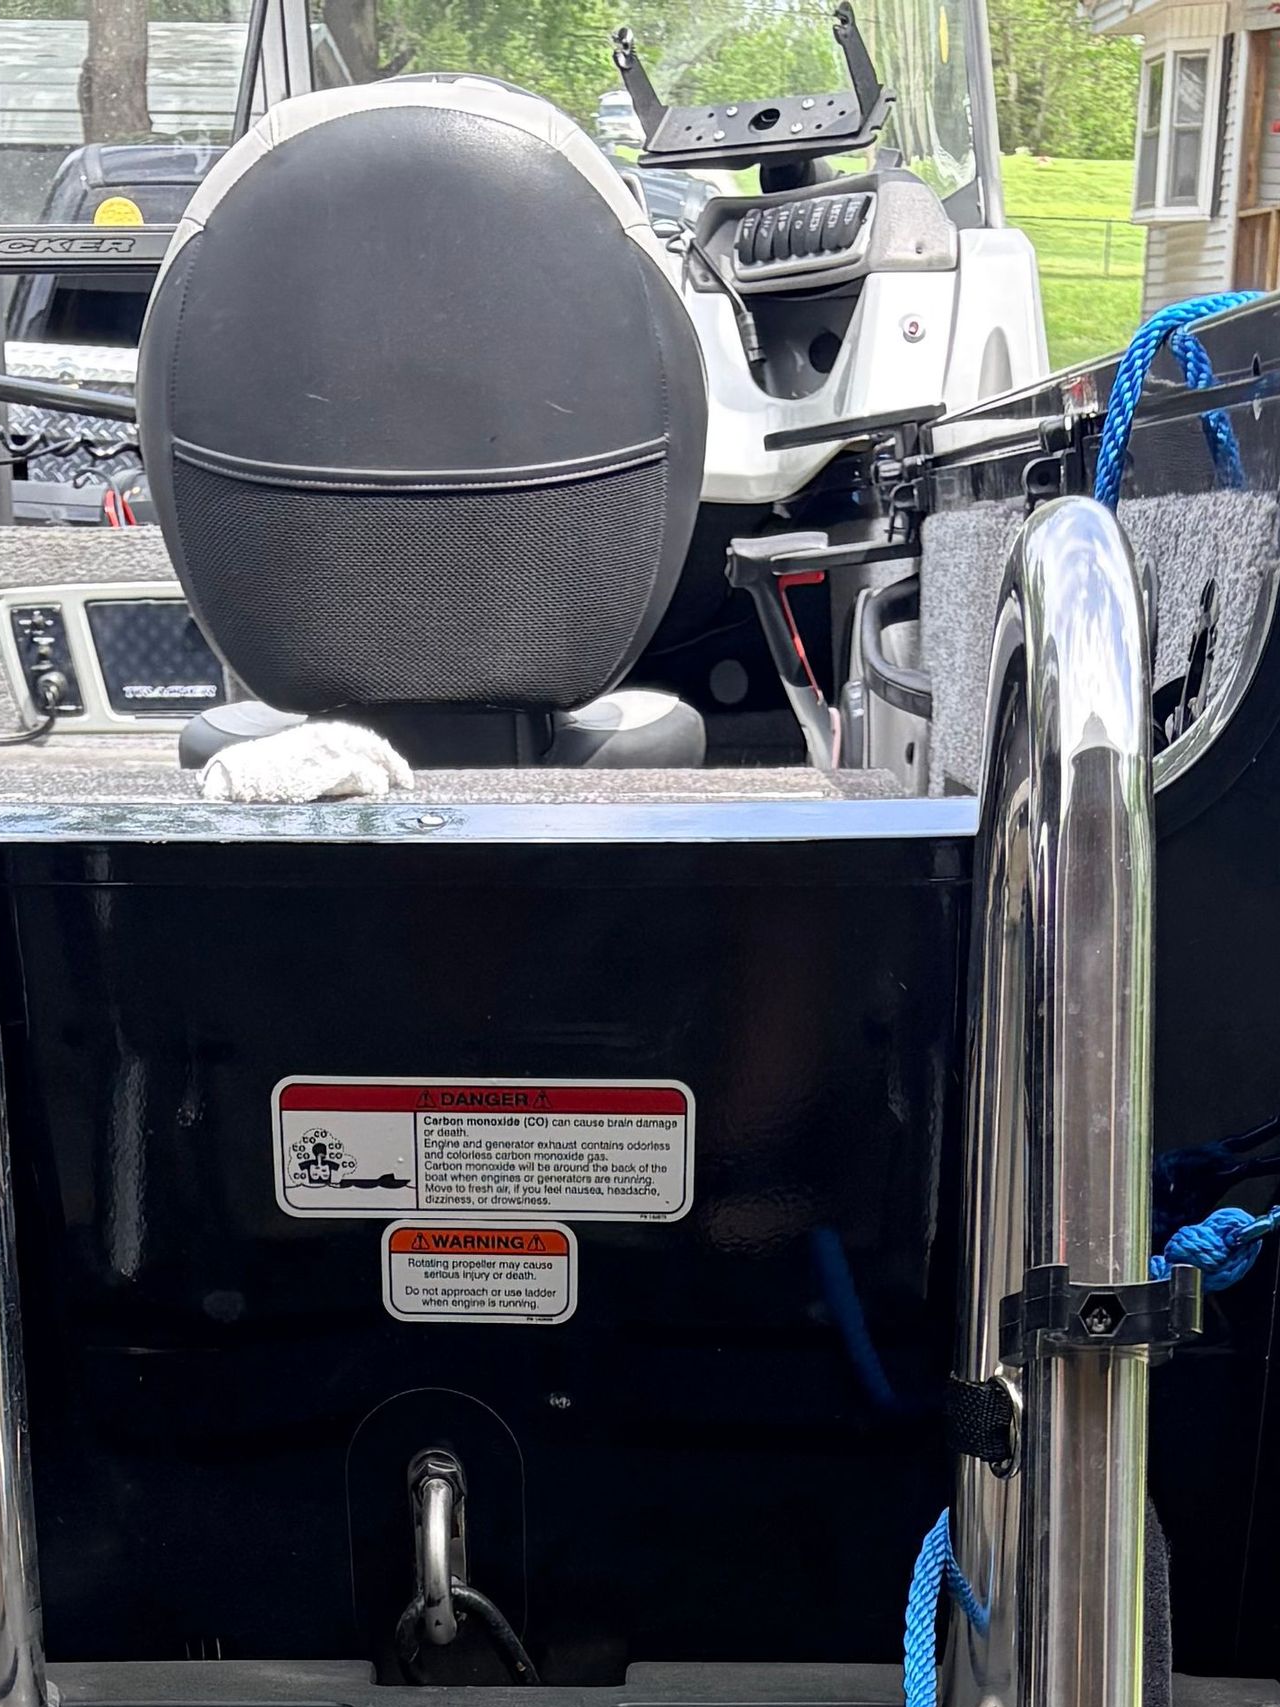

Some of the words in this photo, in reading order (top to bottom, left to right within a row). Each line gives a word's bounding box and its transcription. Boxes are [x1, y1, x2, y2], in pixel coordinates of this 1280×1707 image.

[441, 1092, 528, 1106] DANGER
[423, 1116, 463, 1125] Carbon
[467, 1117, 520, 1126] monoxide
[524, 1117, 548, 1128] (CO)
[552, 1119, 570, 1127] can
[608, 1118, 632, 1127] brain
[636, 1119, 677, 1130] damage
[314, 1130, 327, 1138] CO
[438, 1128, 468, 1137] death.
[424, 1139, 459, 1151] Engine
[463, 1139, 481, 1148] and
[485, 1140, 534, 1150] generator
[538, 1140, 577, 1150] exhaust
[582, 1141, 624, 1150] contains
[627, 1141, 670, 1150] odorless
[424, 1151, 443, 1159] and
[447, 1151, 492, 1159] colorless
[496, 1151, 530, 1160] carbon
[534, 1151, 584, 1161] monoxide
[588, 1154, 608, 1162] gas.
[424, 1161, 462, 1170] Carbon
[465, 1161, 515, 1171] monoxide
[518, 1162, 534, 1171] will
[538, 1163, 550, 1171] be
[554, 1163, 589, 1172] around
[592, 1163, 608, 1172] the
[612, 1163, 636, 1172] back
[639, 1164, 648, 1173] of
[651, 1164, 667, 1173] the
[425, 1172, 447, 1181] boat
[451, 1173, 477, 1182] when
[481, 1174, 521, 1184] engines
[538, 1174, 592, 1185] generators
[614, 1175, 654, 1186] running.
[425, 1184, 452, 1193] Move
[456, 1184, 465, 1193] to
[469, 1184, 493, 1193] fresh
[496, 1185, 510, 1194] air,
[514, 1185, 519, 1193] if
[522, 1187, 540, 1196] you
[544, 1184, 562, 1194] feel
[565, 1186, 604, 1195] nausea,
[608, 1186, 660, 1196] headache,
[425, 1195, 474, 1205] dizziness,
[491, 1195, 550, 1205] drowsiness.
[432, 1235, 524, 1249] WARNING
[408, 1258, 448, 1269] Rotating
[452, 1259, 495, 1272] propeller
[499, 1261, 520, 1270] may
[523, 1262, 552, 1270] cause
[424, 1271, 459, 1279] serious
[463, 1271, 489, 1281] injury
[506, 1271, 536, 1280] death.
[405, 1286, 419, 1295] Do
[422, 1287, 438, 1296] not
[441, 1287, 487, 1298] approach
[505, 1289, 521, 1297] use
[525, 1288, 556, 1298] ladder
[422, 1299, 448, 1307] when
[452, 1299, 485, 1309] engine
[488, 1299, 496, 1307] is
[499, 1300, 539, 1310] running.
